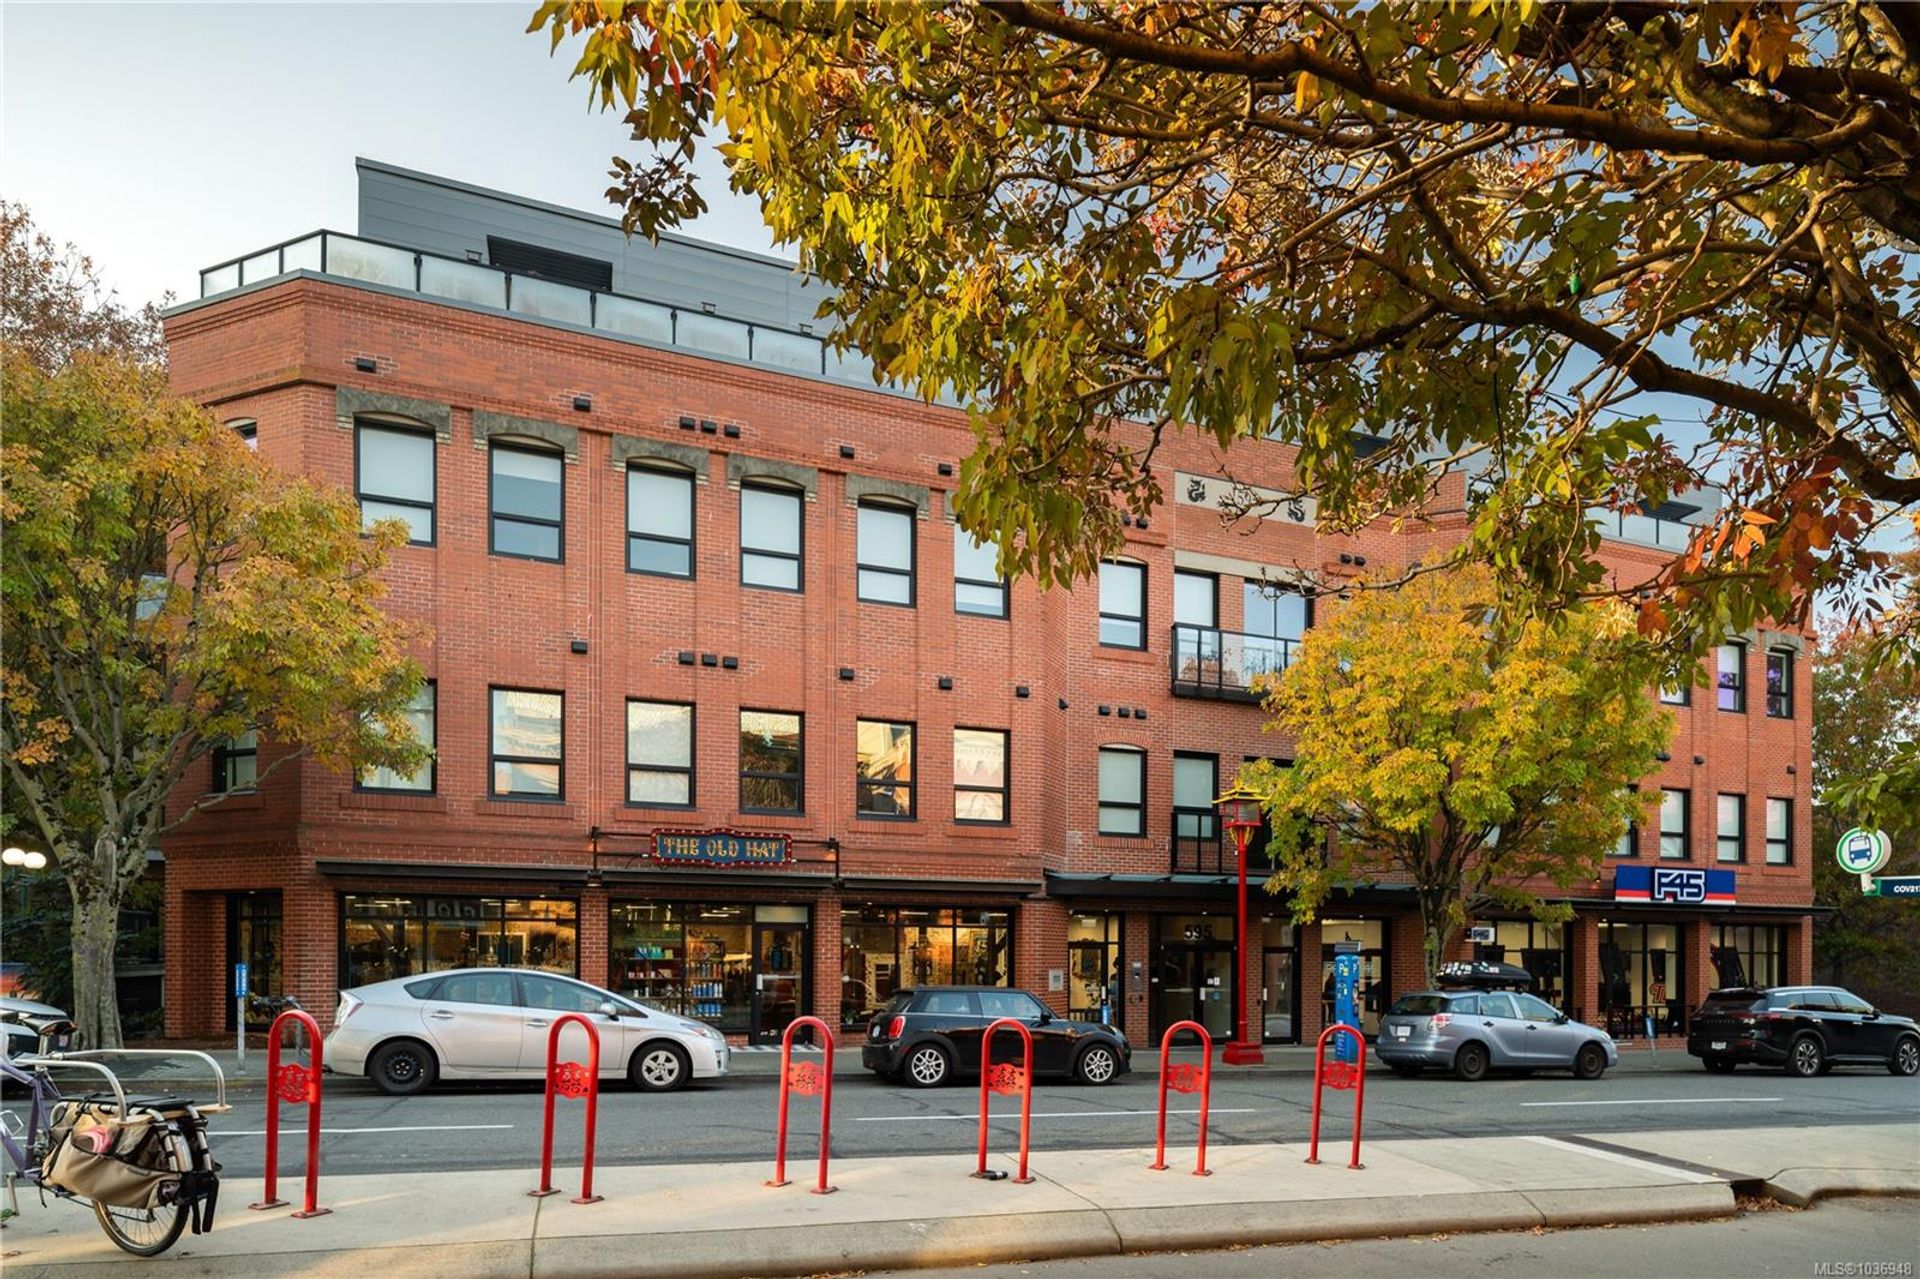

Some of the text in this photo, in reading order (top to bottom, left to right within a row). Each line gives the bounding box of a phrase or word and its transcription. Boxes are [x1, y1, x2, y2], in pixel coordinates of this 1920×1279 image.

[663, 836, 779, 859] THE OLD HAT
[1654, 867, 1706, 902] F45
[1184, 924, 1213, 939] 595
